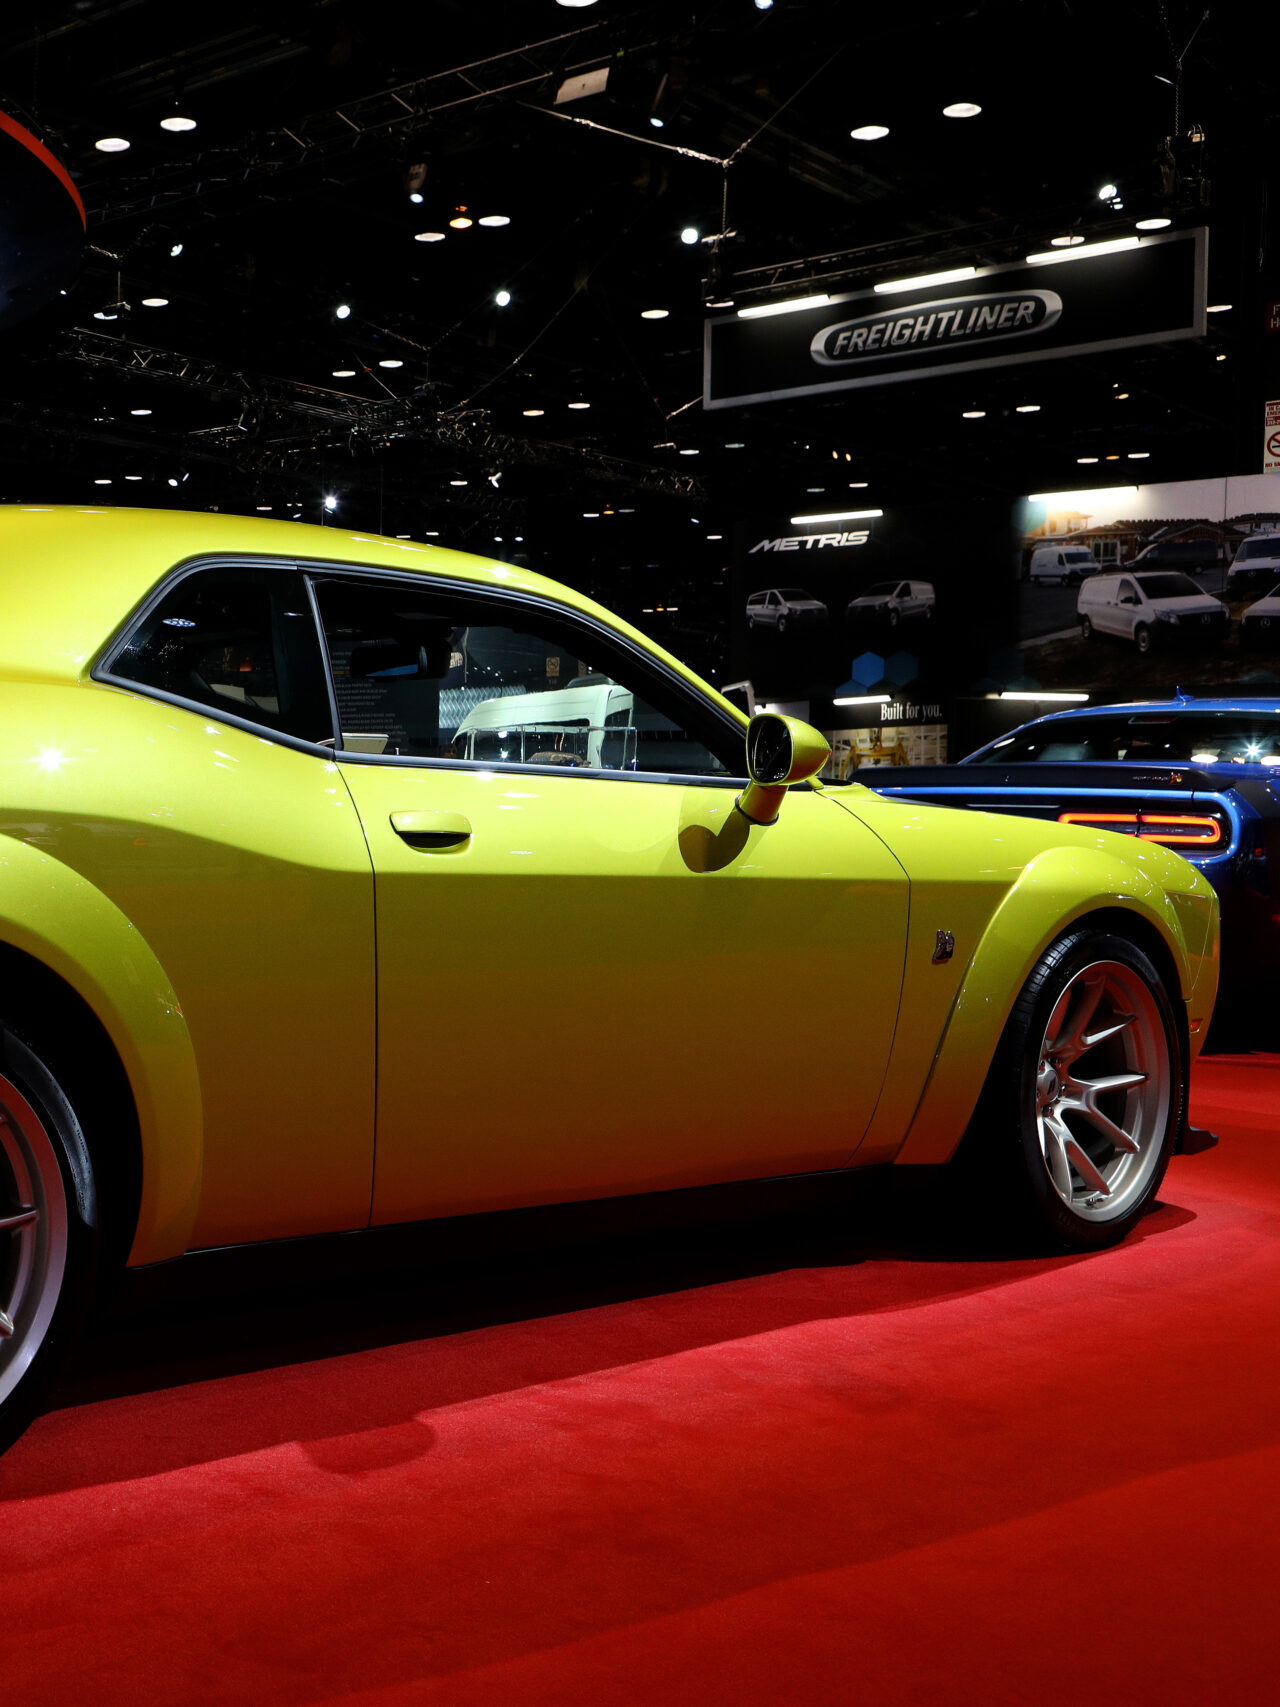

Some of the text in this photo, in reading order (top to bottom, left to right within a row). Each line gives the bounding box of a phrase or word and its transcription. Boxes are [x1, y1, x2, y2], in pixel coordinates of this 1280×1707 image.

[833, 301, 1036, 355] FREIGHTLINER
[748, 530, 869, 553] METRIS
[881, 701, 942, 722] Built for you.
